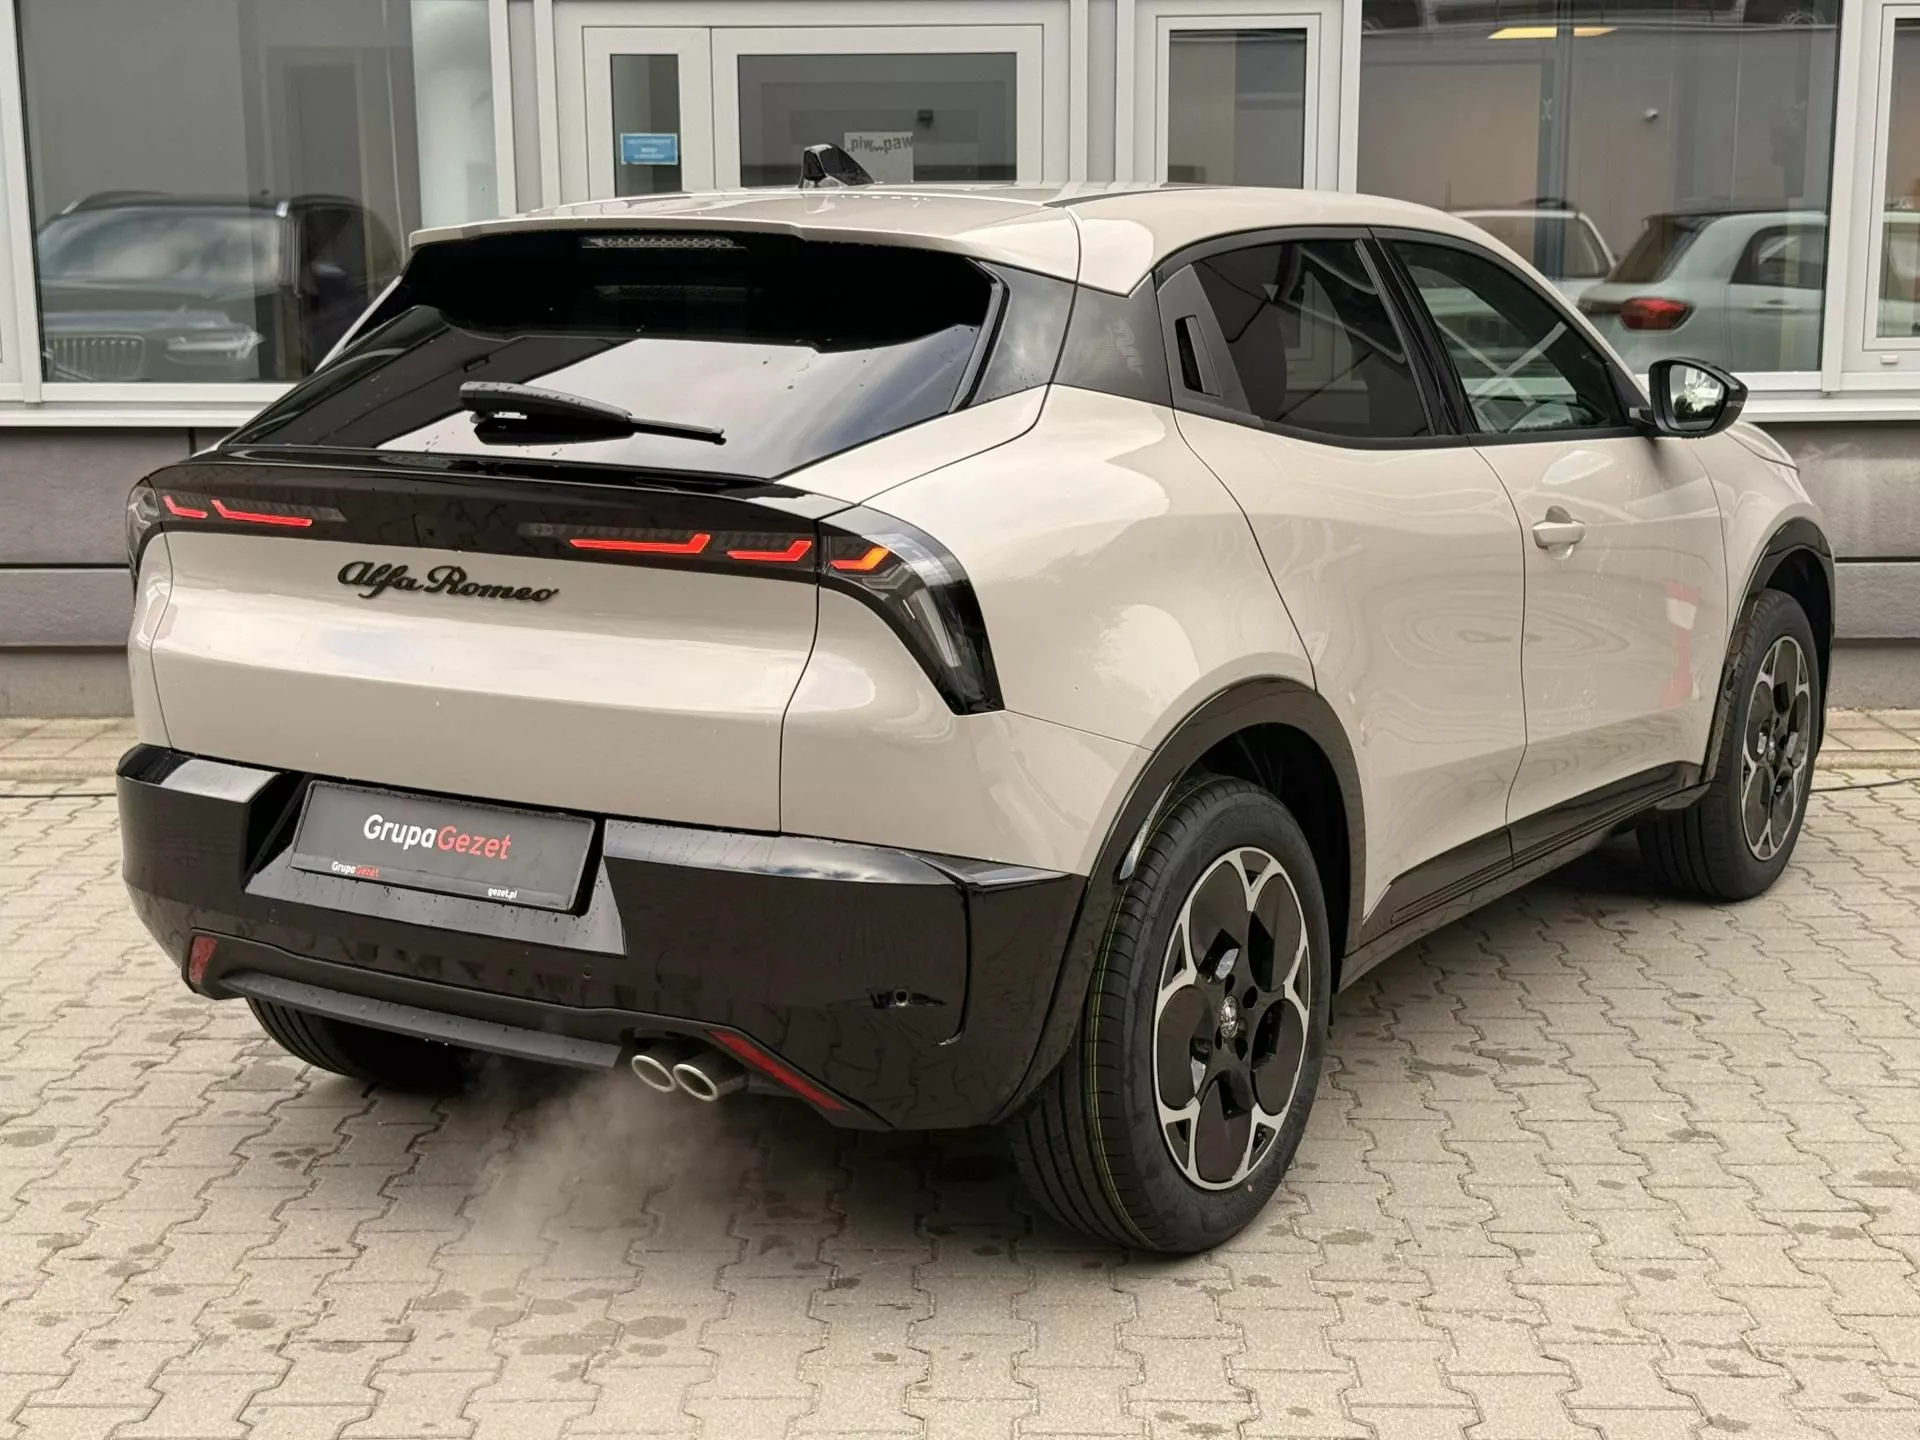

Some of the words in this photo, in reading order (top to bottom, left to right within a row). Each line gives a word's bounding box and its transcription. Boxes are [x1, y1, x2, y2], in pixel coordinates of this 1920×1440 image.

[337, 561, 424, 599] Alfa
[423, 565, 559, 602] Romeo
[363, 814, 512, 860] GrupaGezet
